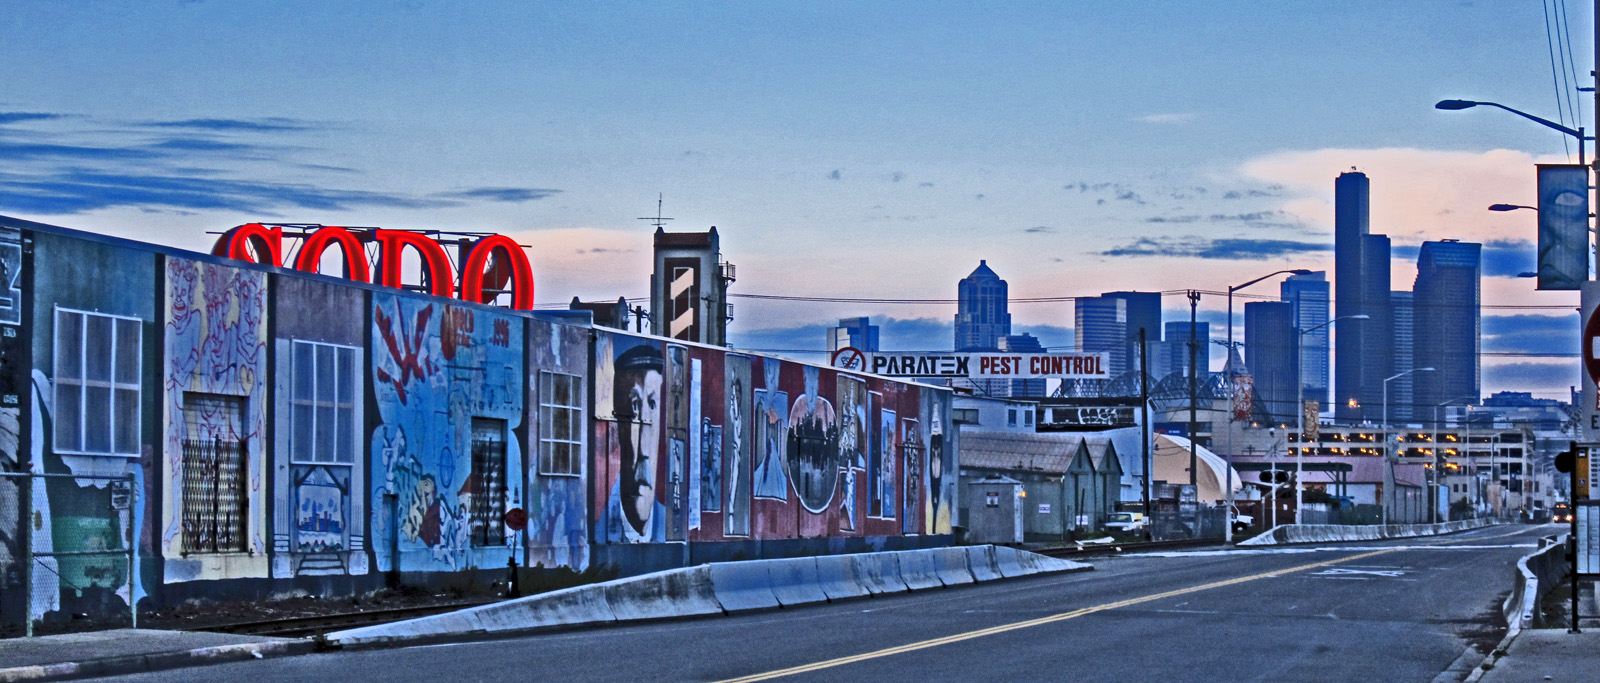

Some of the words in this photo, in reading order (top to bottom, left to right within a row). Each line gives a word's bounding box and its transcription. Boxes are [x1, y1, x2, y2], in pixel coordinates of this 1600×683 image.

[872, 355, 970, 375] PARATEX
[980, 356, 1023, 376] PEST
[1030, 356, 1105, 376] CONTROL
